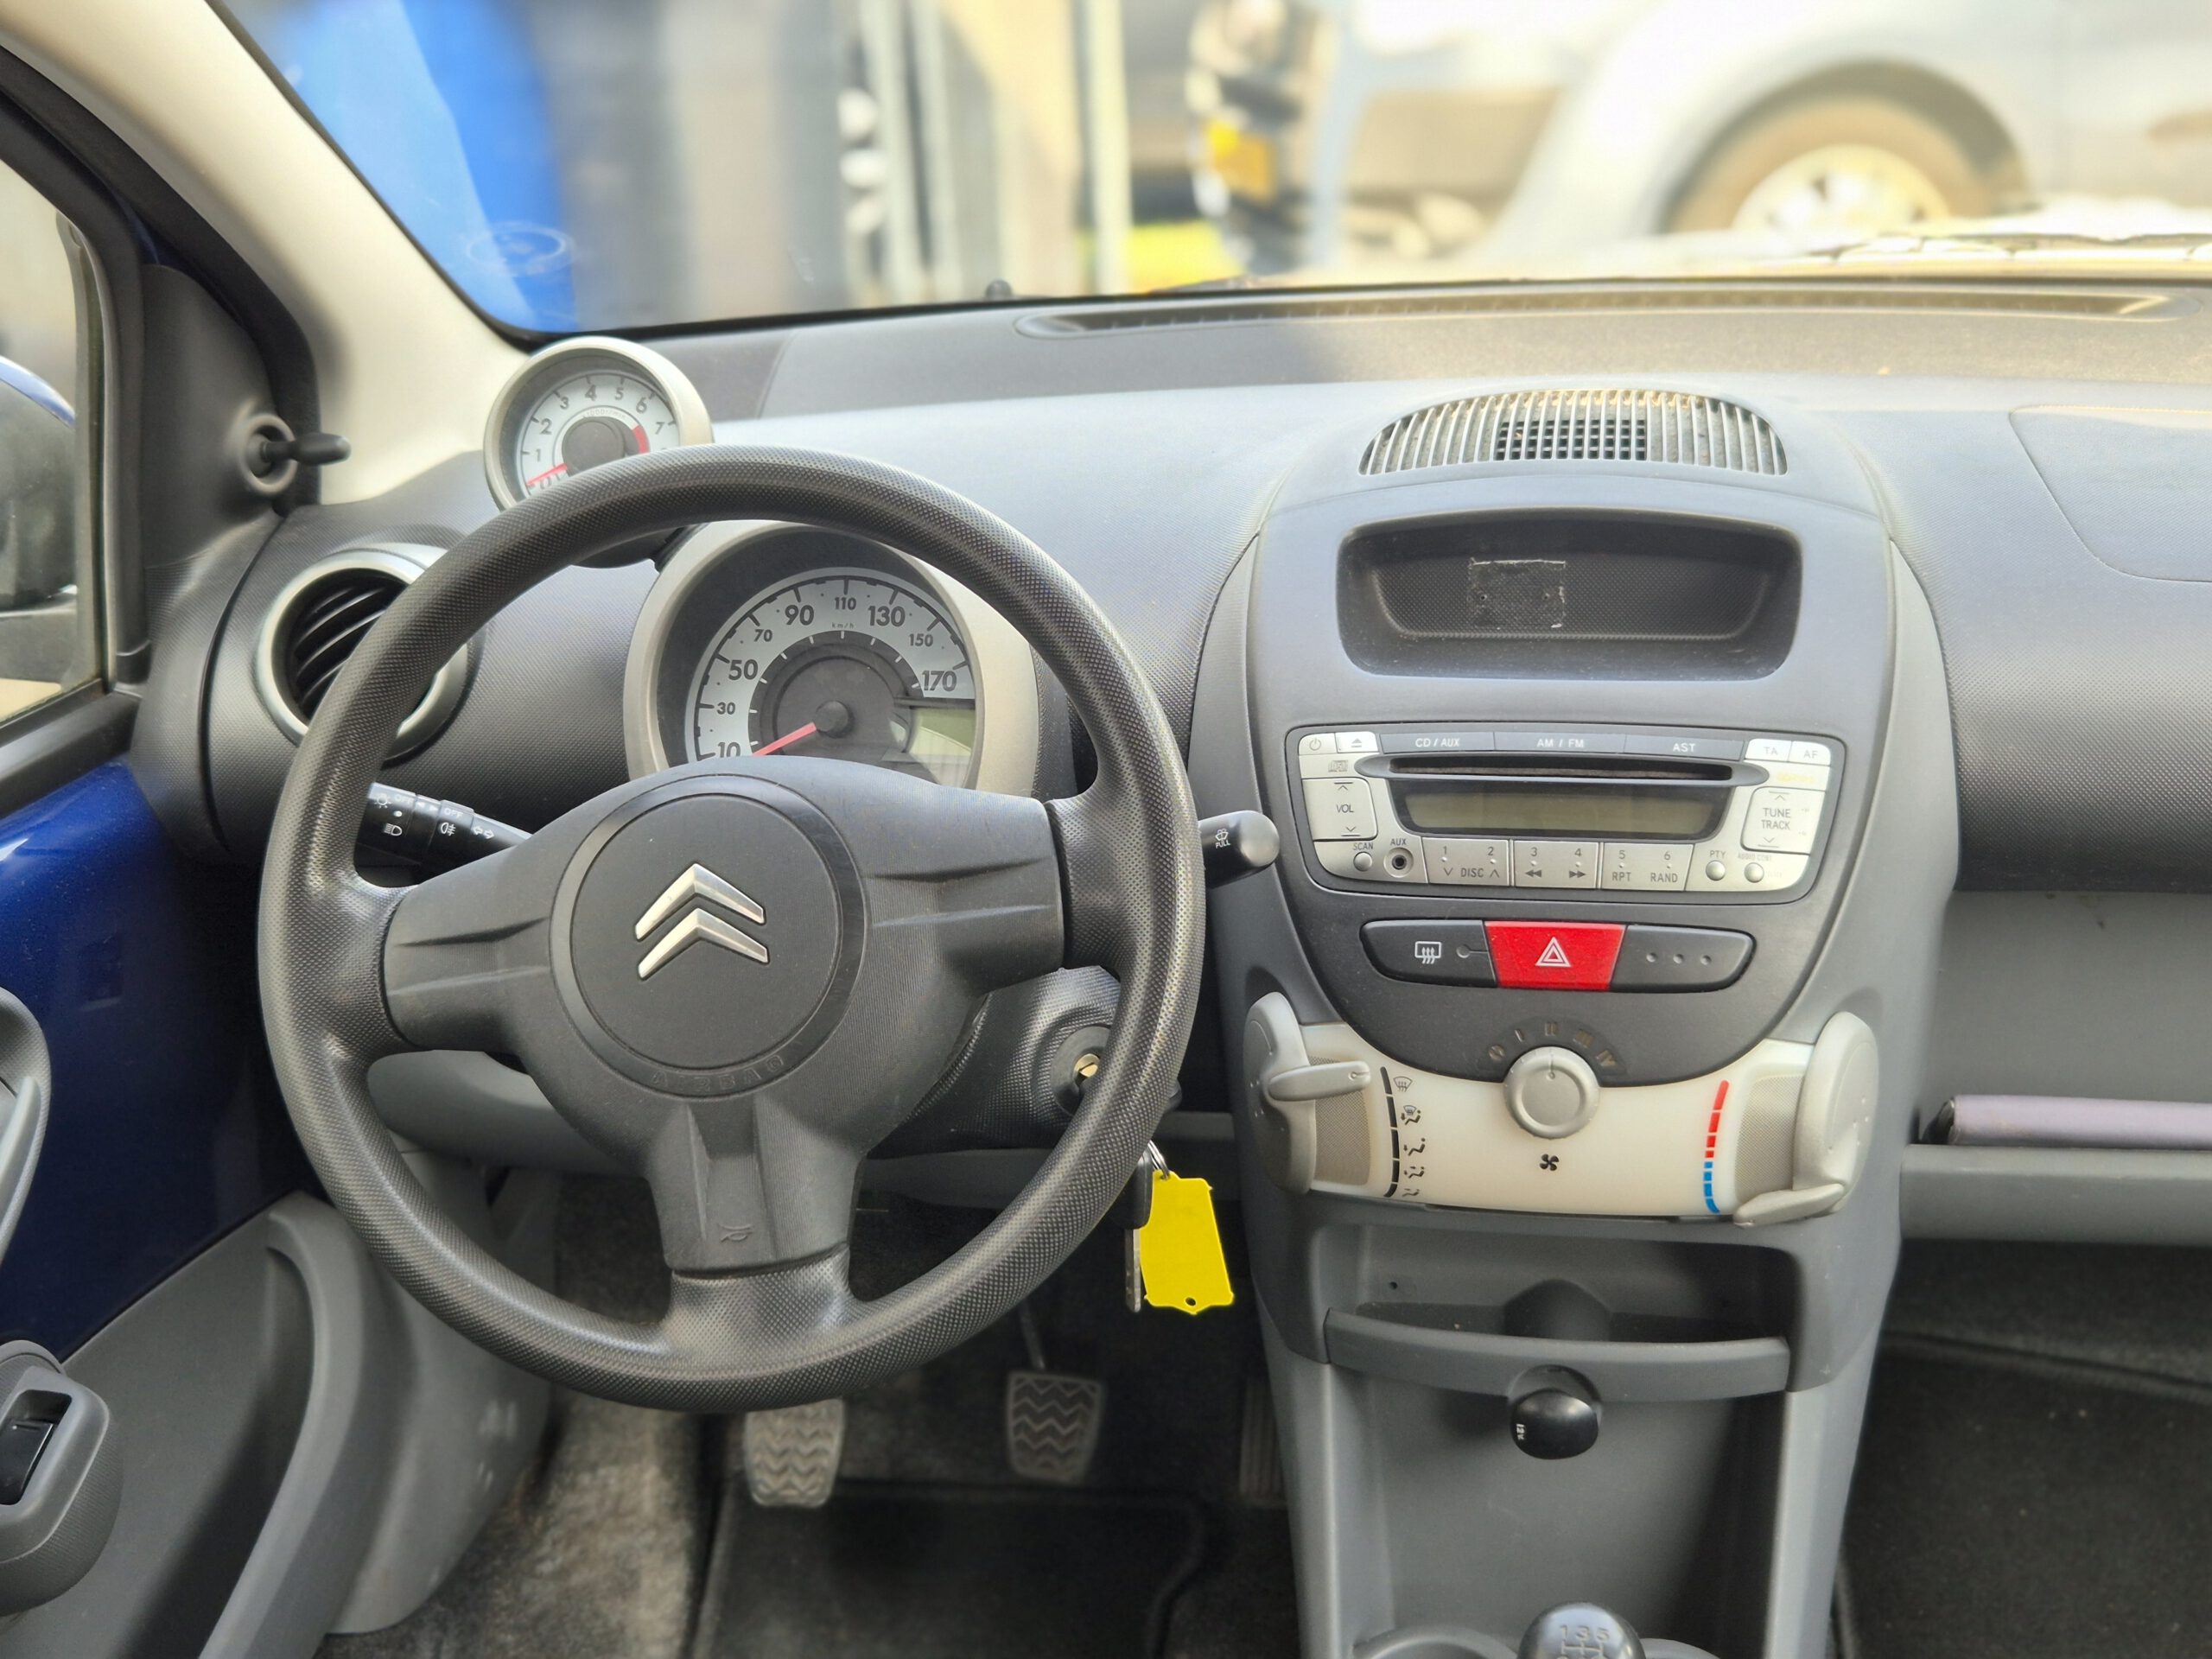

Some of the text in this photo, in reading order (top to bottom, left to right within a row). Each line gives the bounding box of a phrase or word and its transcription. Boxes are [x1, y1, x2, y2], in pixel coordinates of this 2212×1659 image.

[584, 385, 597, 401] 4
[614, 387, 625, 401] 5
[559, 397, 569, 410] 3
[635, 397, 648, 414] 6
[539, 418, 552, 435] 2
[654, 422, 665, 435] 7
[535, 448, 542, 463] 1
[834, 596, 857, 611] 110
[785, 604, 815, 626] 90
[868, 606, 906, 627] 130
[754, 628, 773, 643] 70
[908, 632, 934, 647] 150
[728, 659, 759, 681] 50
[921, 670, 957, 691] 170
[716, 702, 736, 715] 30
[717, 741, 741, 757] 10
[1536, 738, 1554, 748] AM
[1568, 739, 1584, 749] FM
[1672, 742, 1697, 753] AST
[1764, 747, 1778, 756] TA
[1803, 750, 1818, 760] AF
[394, 793, 415, 804] OFF
[443, 808, 464, 819] OFF
[1336, 804, 1354, 814] VOL
[1763, 807, 1791, 818] TUNE
[1761, 819, 1791, 830] TRACK
[1352, 842, 1374, 852] SCAN
[1389, 837, 1408, 847] AUX
[1442, 846, 1448, 855] 1
[1487, 846, 1495, 856] 2
[1530, 847, 1538, 857] 3
[1573, 848, 1582, 858] 4
[1618, 850, 1626, 860] 5
[1663, 851, 1671, 861] 6
[1709, 850, 1726, 859] PTY
[1460, 868, 1484, 878] DISC
[1611, 872, 1632, 883] RPT
[1650, 873, 1679, 883] RAND
